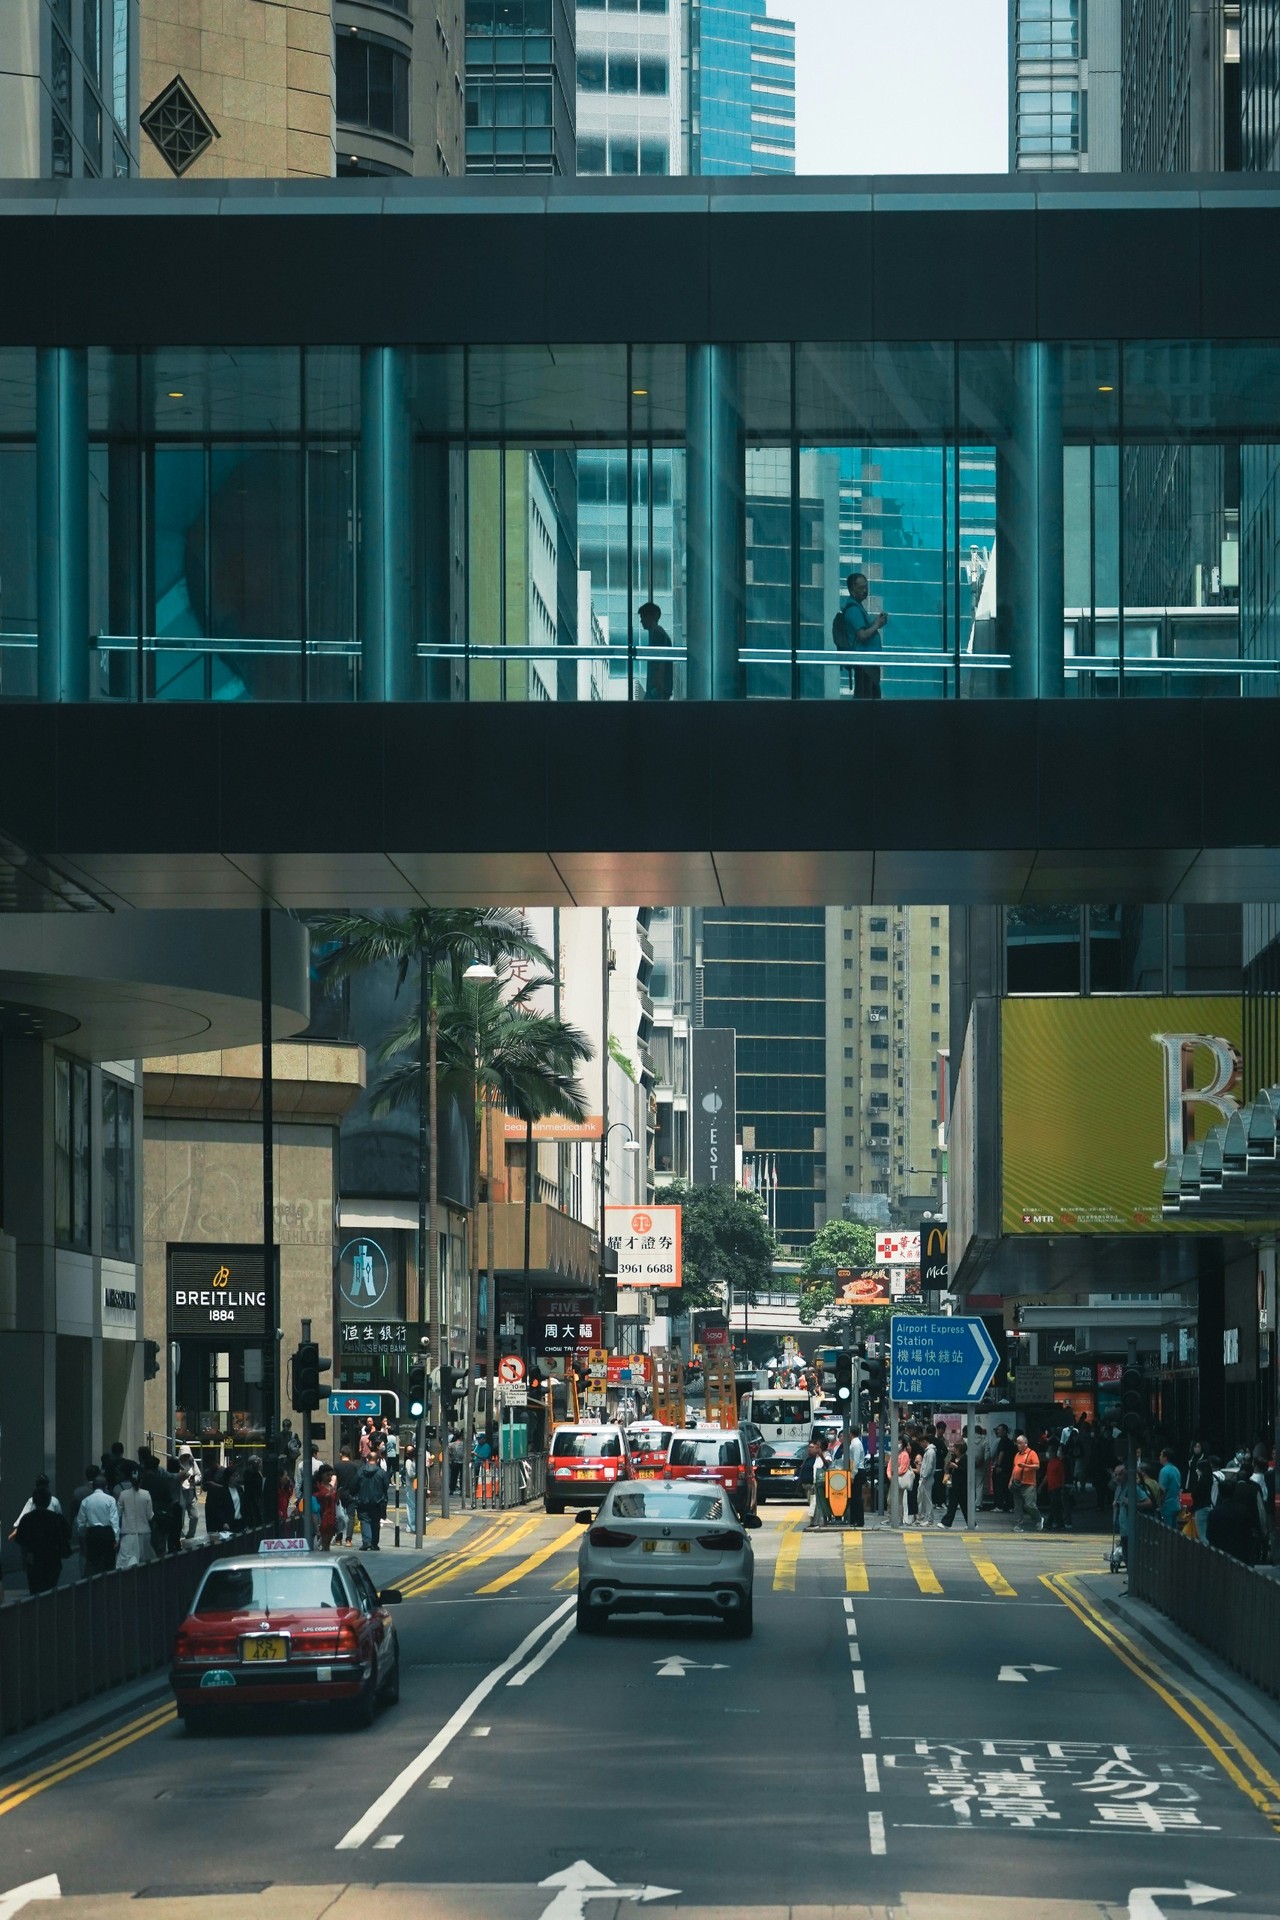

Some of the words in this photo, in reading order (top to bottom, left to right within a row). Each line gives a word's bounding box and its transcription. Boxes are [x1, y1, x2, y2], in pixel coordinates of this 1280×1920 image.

[1033, 1215, 1054, 1223] MTR
[607, 1236, 673, 1250] 耀才證券
[619, 1264, 642, 1273] 3961
[647, 1264, 673, 1273] 6688
[175, 1291, 266, 1306] BREITLING
[550, 1303, 580, 1312] FIVE
[209, 1310, 235, 1321] 1884
[342, 1325, 407, 1341] 恒生銀行
[544, 1323, 593, 1338] 周大福
[897, 1323, 928, 1334] Airport
[931, 1324, 965, 1335] Express
[896, 1336, 934, 1346] Station
[367, 1344, 388, 1353] SENG
[390, 1344, 406, 1353] BANK
[897, 1349, 964, 1364] 機場快綫站
[896, 1366, 940, 1376] Kowloon
[897, 1379, 923, 1393] 九龍
[264, 1540, 303, 1550] TAXI
[255, 1639, 273, 1649] RS
[252, 1648, 277, 1660] 447
[914, 1739, 1169, 1761] KEEP
[882, 1753, 1222, 1781] CLEAR
[931, 1796, 1222, 1833] 停車
